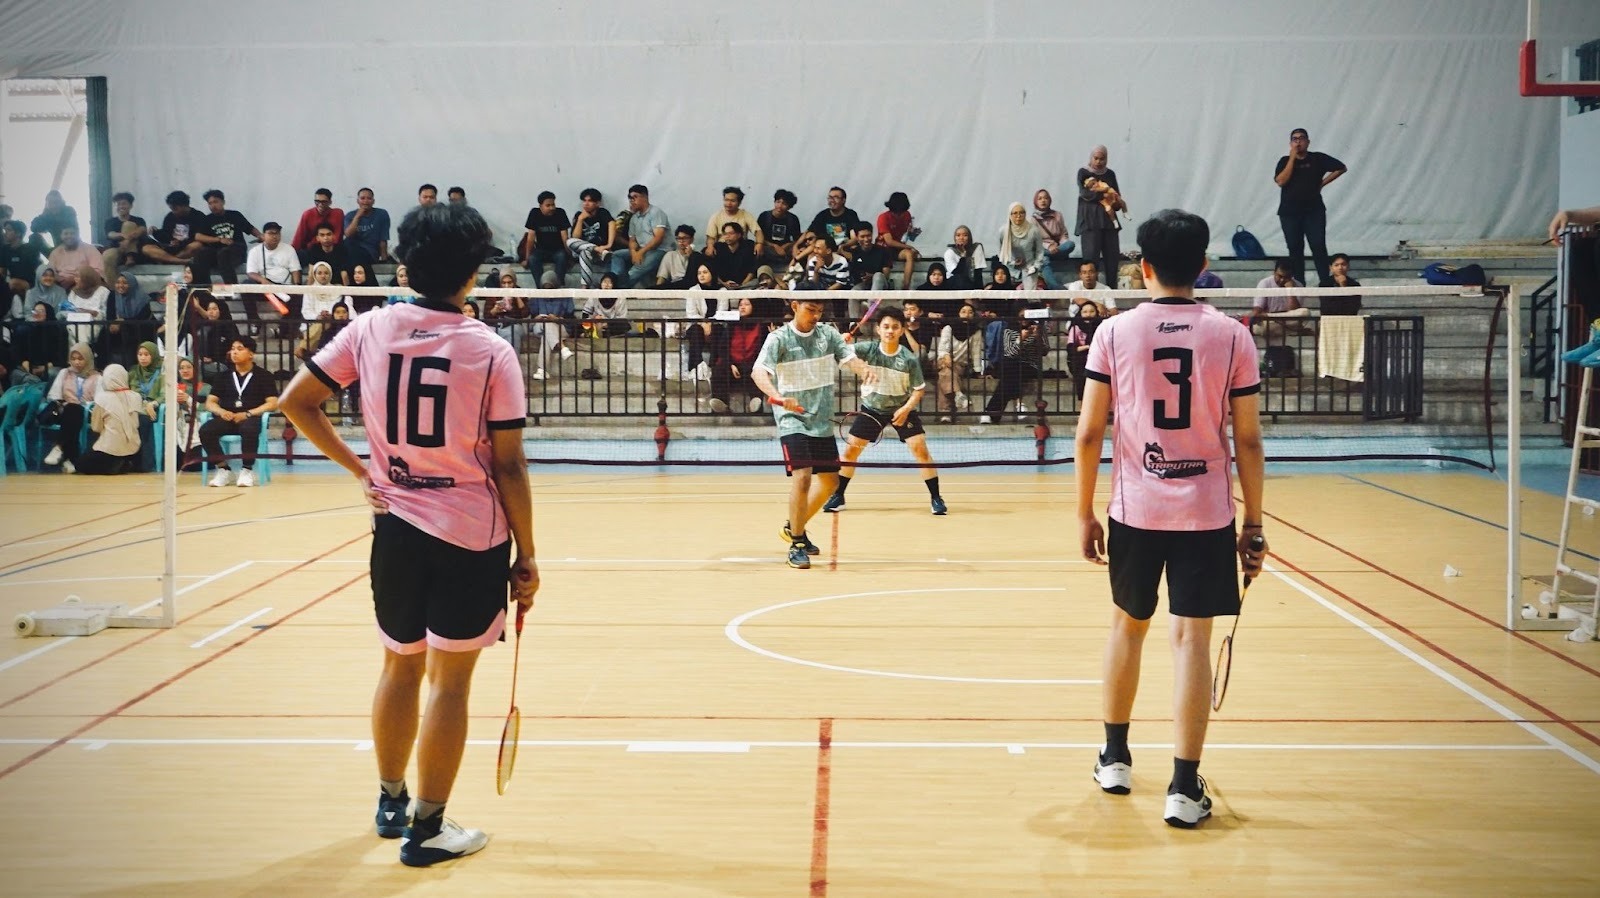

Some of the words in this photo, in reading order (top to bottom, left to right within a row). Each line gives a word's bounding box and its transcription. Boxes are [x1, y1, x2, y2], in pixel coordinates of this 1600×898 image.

[386, 352, 451, 448] 16
[1153, 347, 1193, 430] 3
[1149, 461, 1204, 471] TRIPUTRA
